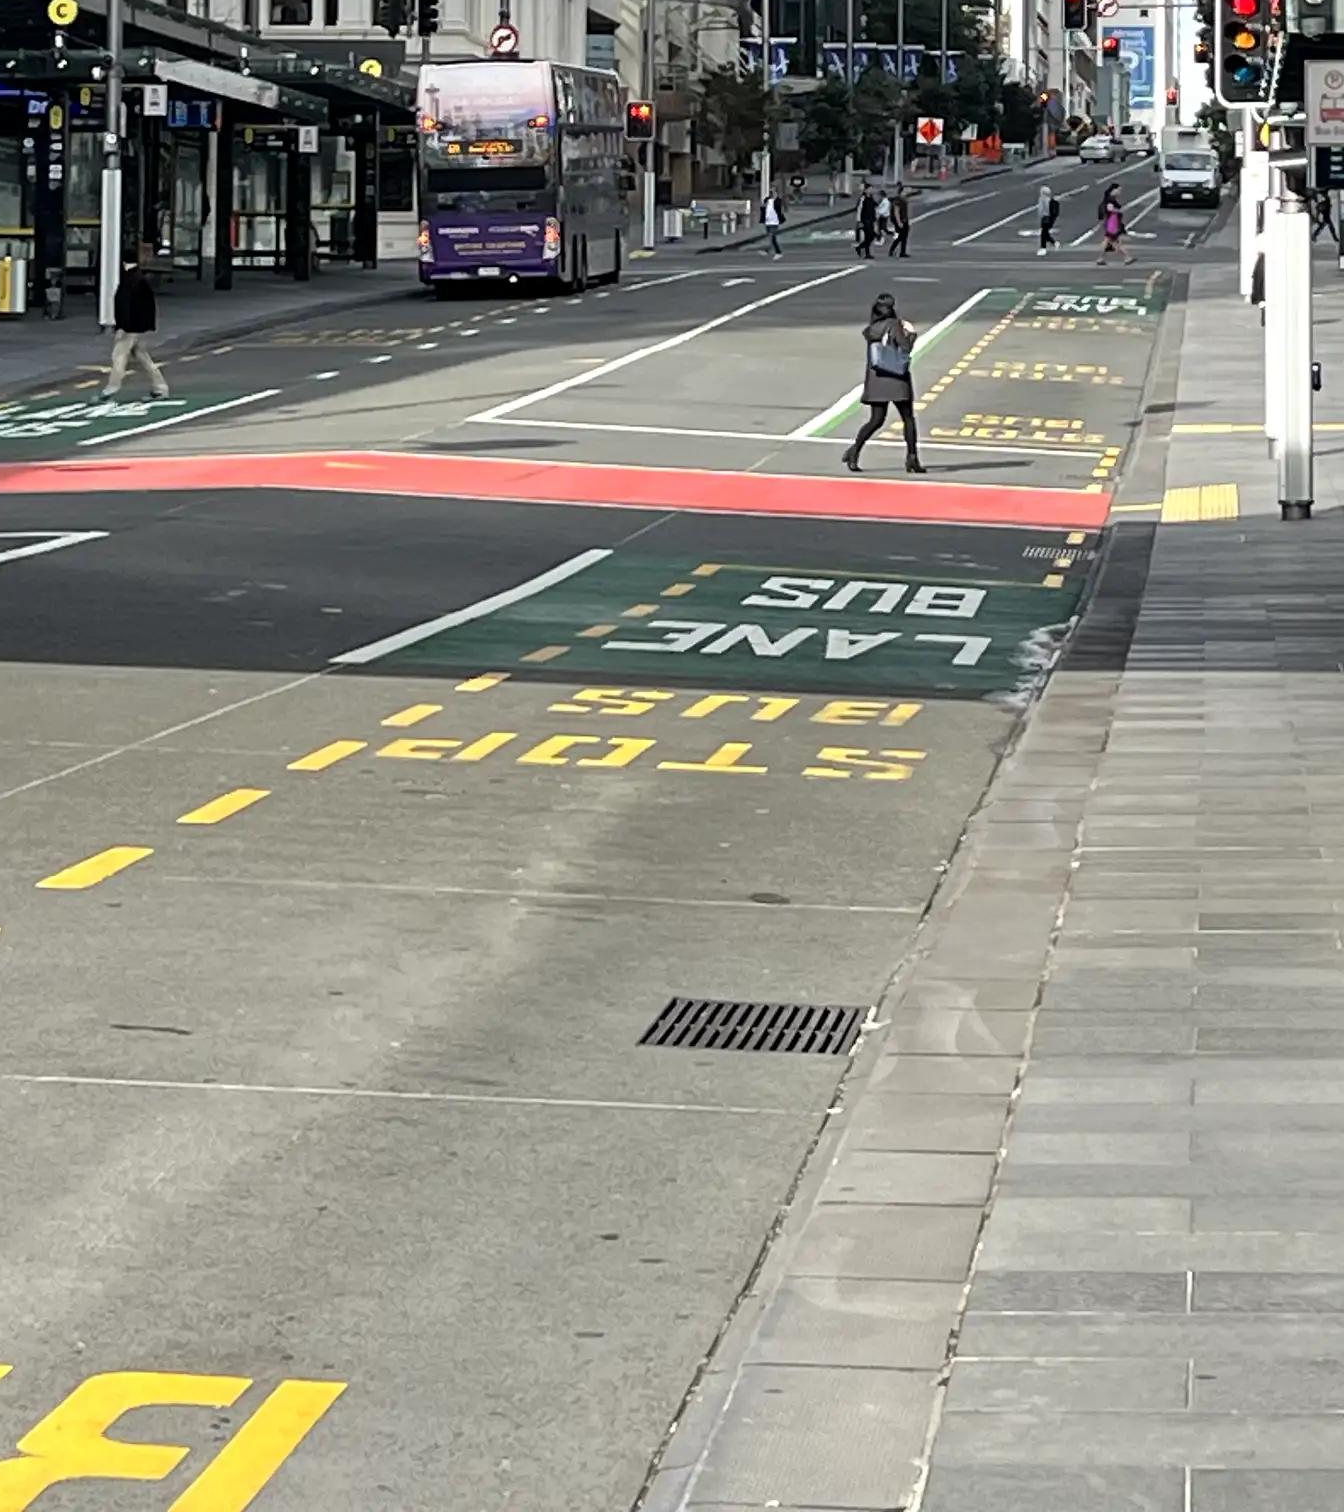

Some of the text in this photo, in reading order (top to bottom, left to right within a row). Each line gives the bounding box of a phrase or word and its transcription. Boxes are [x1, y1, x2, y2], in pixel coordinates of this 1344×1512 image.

[56, 3, 68, 19] C
[741, 574, 987, 619] BUS
[601, 619, 993, 667] LANE
[547, 689, 925, 727] BUS
[375, 732, 928, 781] STOP
